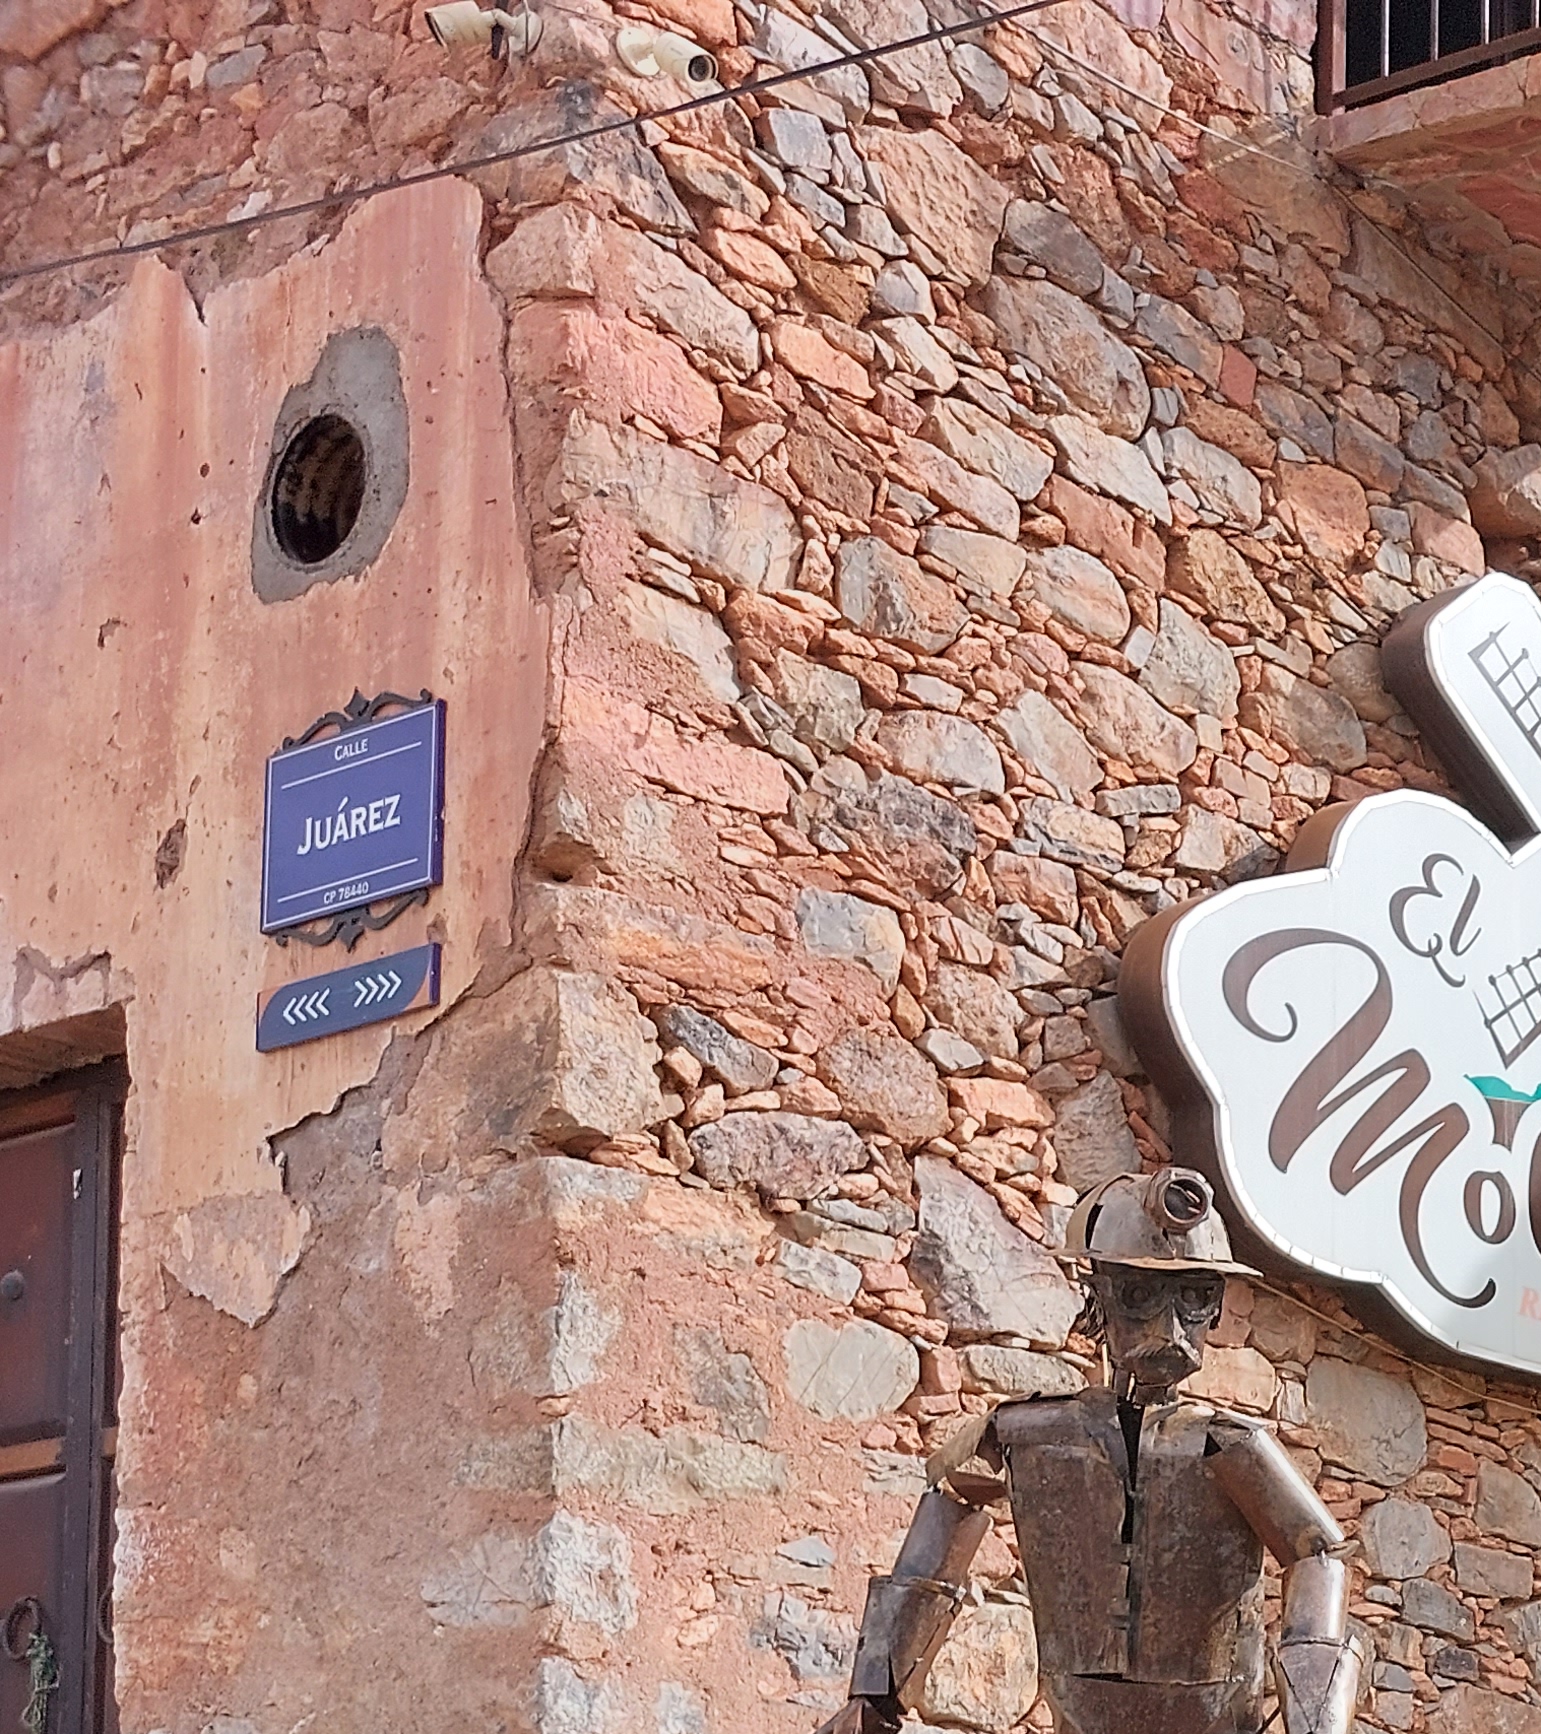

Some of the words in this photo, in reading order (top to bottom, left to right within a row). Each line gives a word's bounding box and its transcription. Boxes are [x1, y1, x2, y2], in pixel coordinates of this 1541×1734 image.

[334, 738, 369, 761] CALLE
[297, 794, 401, 855] JUÁREZ
[324, 890, 337, 905] CP
[338, 881, 369, 901] 78440
[1388, 853, 1481, 988] El
